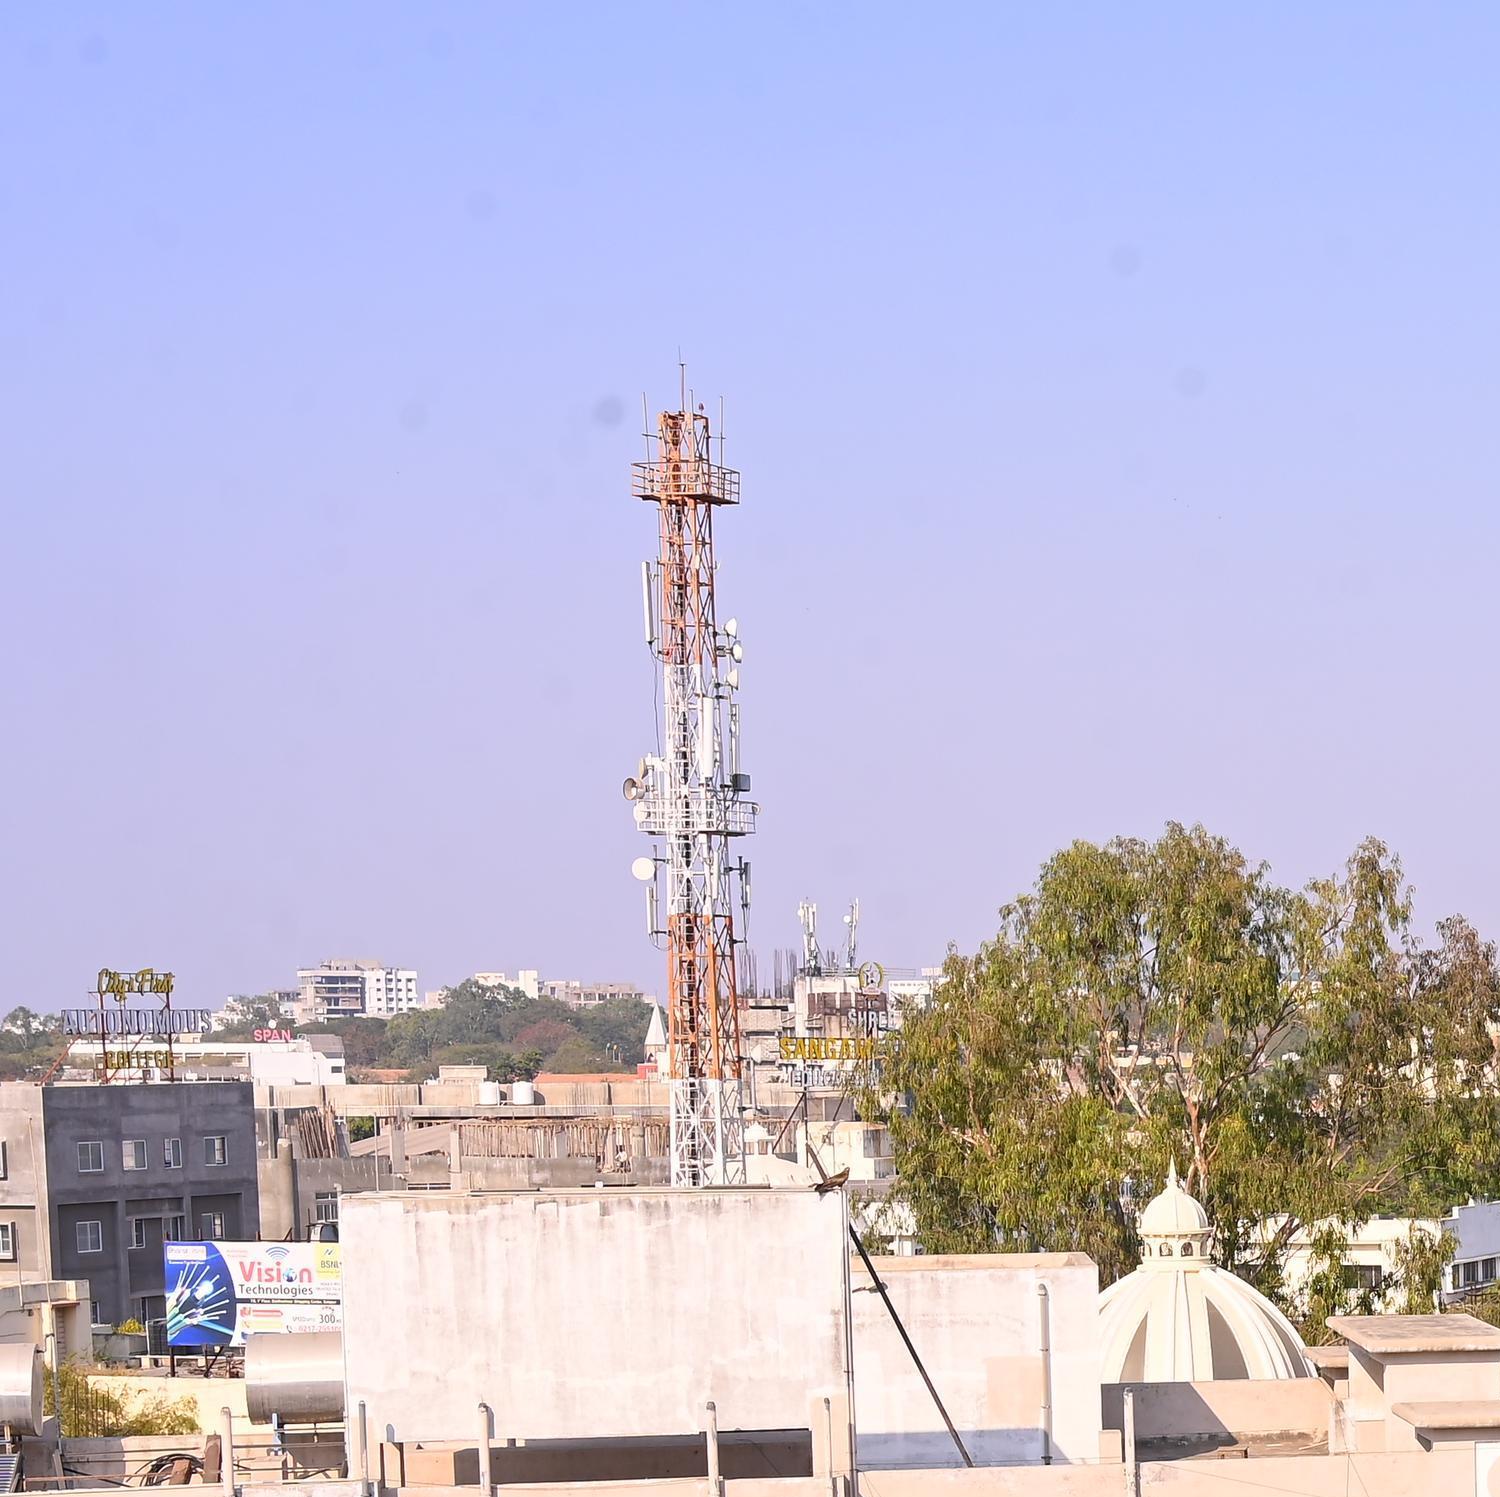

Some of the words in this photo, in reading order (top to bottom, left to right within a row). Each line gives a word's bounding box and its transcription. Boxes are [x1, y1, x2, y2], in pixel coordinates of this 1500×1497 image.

[62, 1009, 212, 1035] AUTONOMOUS
[254, 1029, 293, 1042] SPAN
[239, 1261, 312, 1283] Vision
[239, 1284, 313, 1297] Technologies
